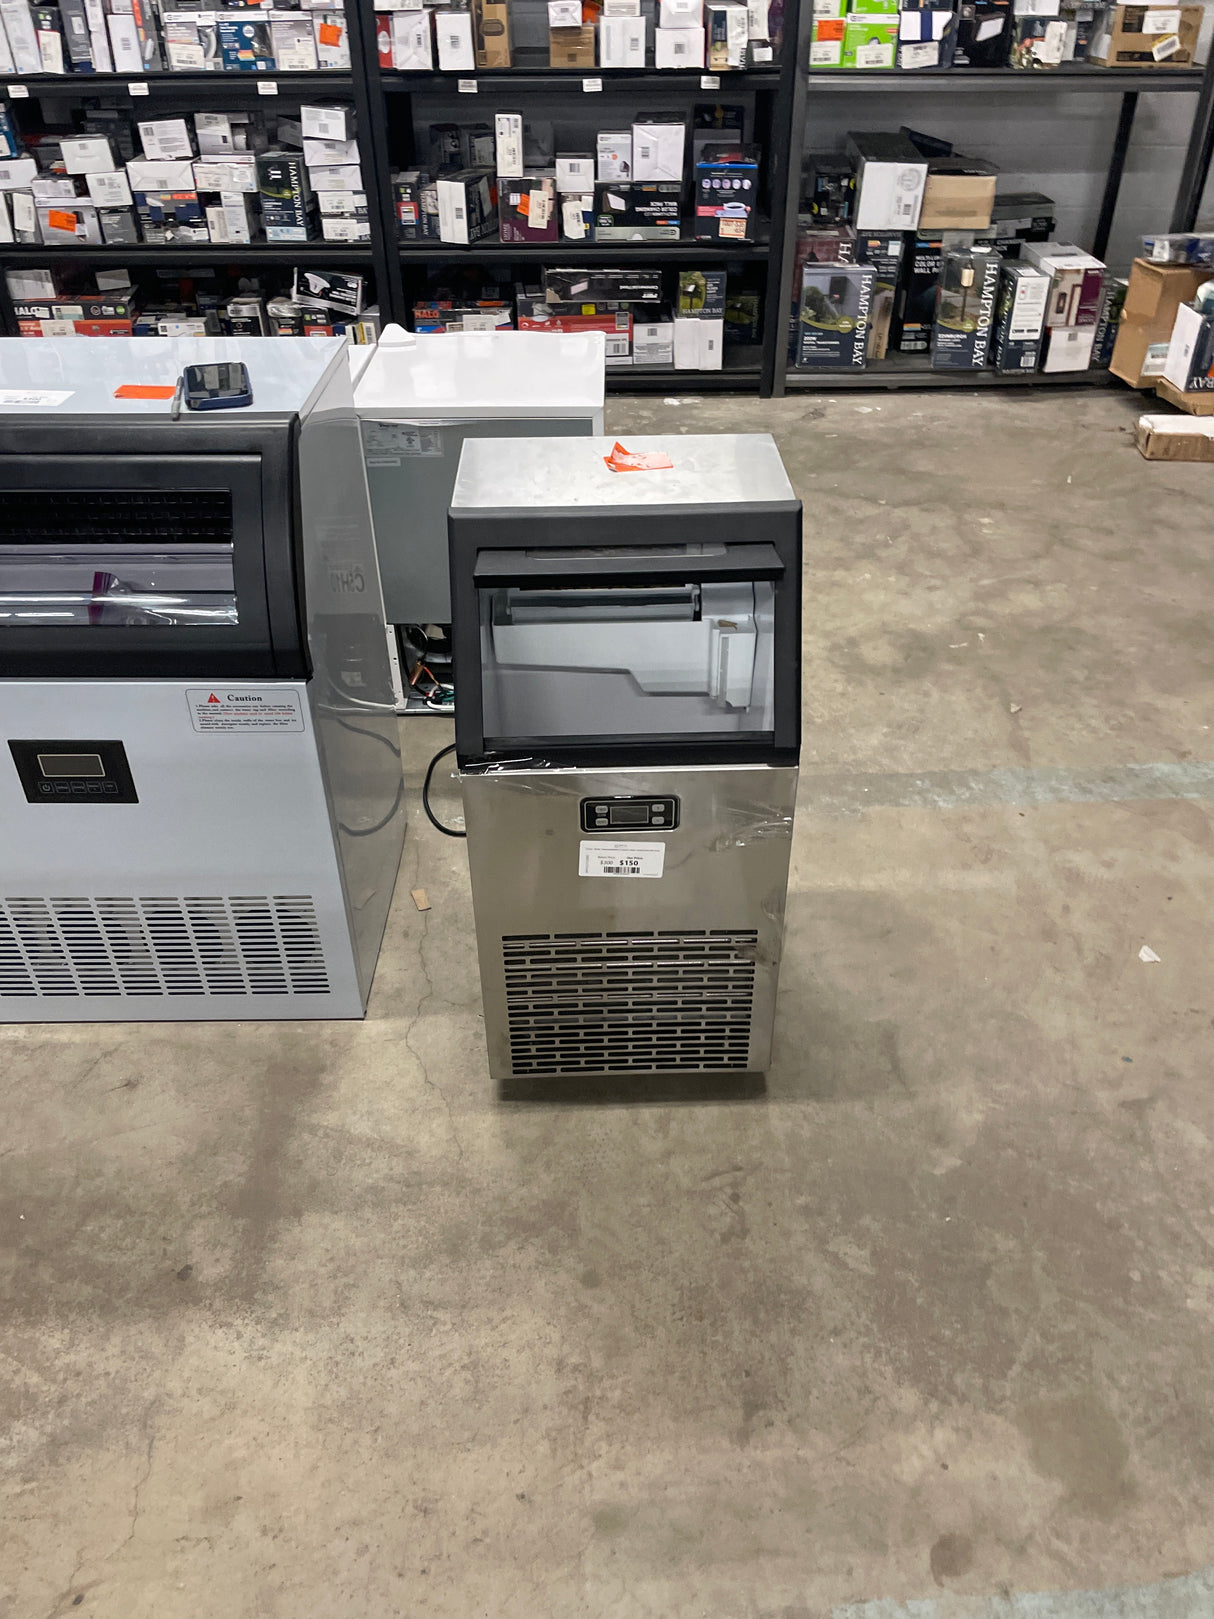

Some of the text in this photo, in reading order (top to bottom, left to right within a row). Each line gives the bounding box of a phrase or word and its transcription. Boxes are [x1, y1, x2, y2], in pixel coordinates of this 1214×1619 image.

[288, 162, 304, 227] HAMPTON BAY
[414, 310, 438, 318] HALO
[852, 274, 872, 365] HAMPTON BAY
[971, 263, 998, 367] HAMPTON BAY
[1096, 290, 1115, 345] HAMPTON
[227, 694, 262, 702] Caution
